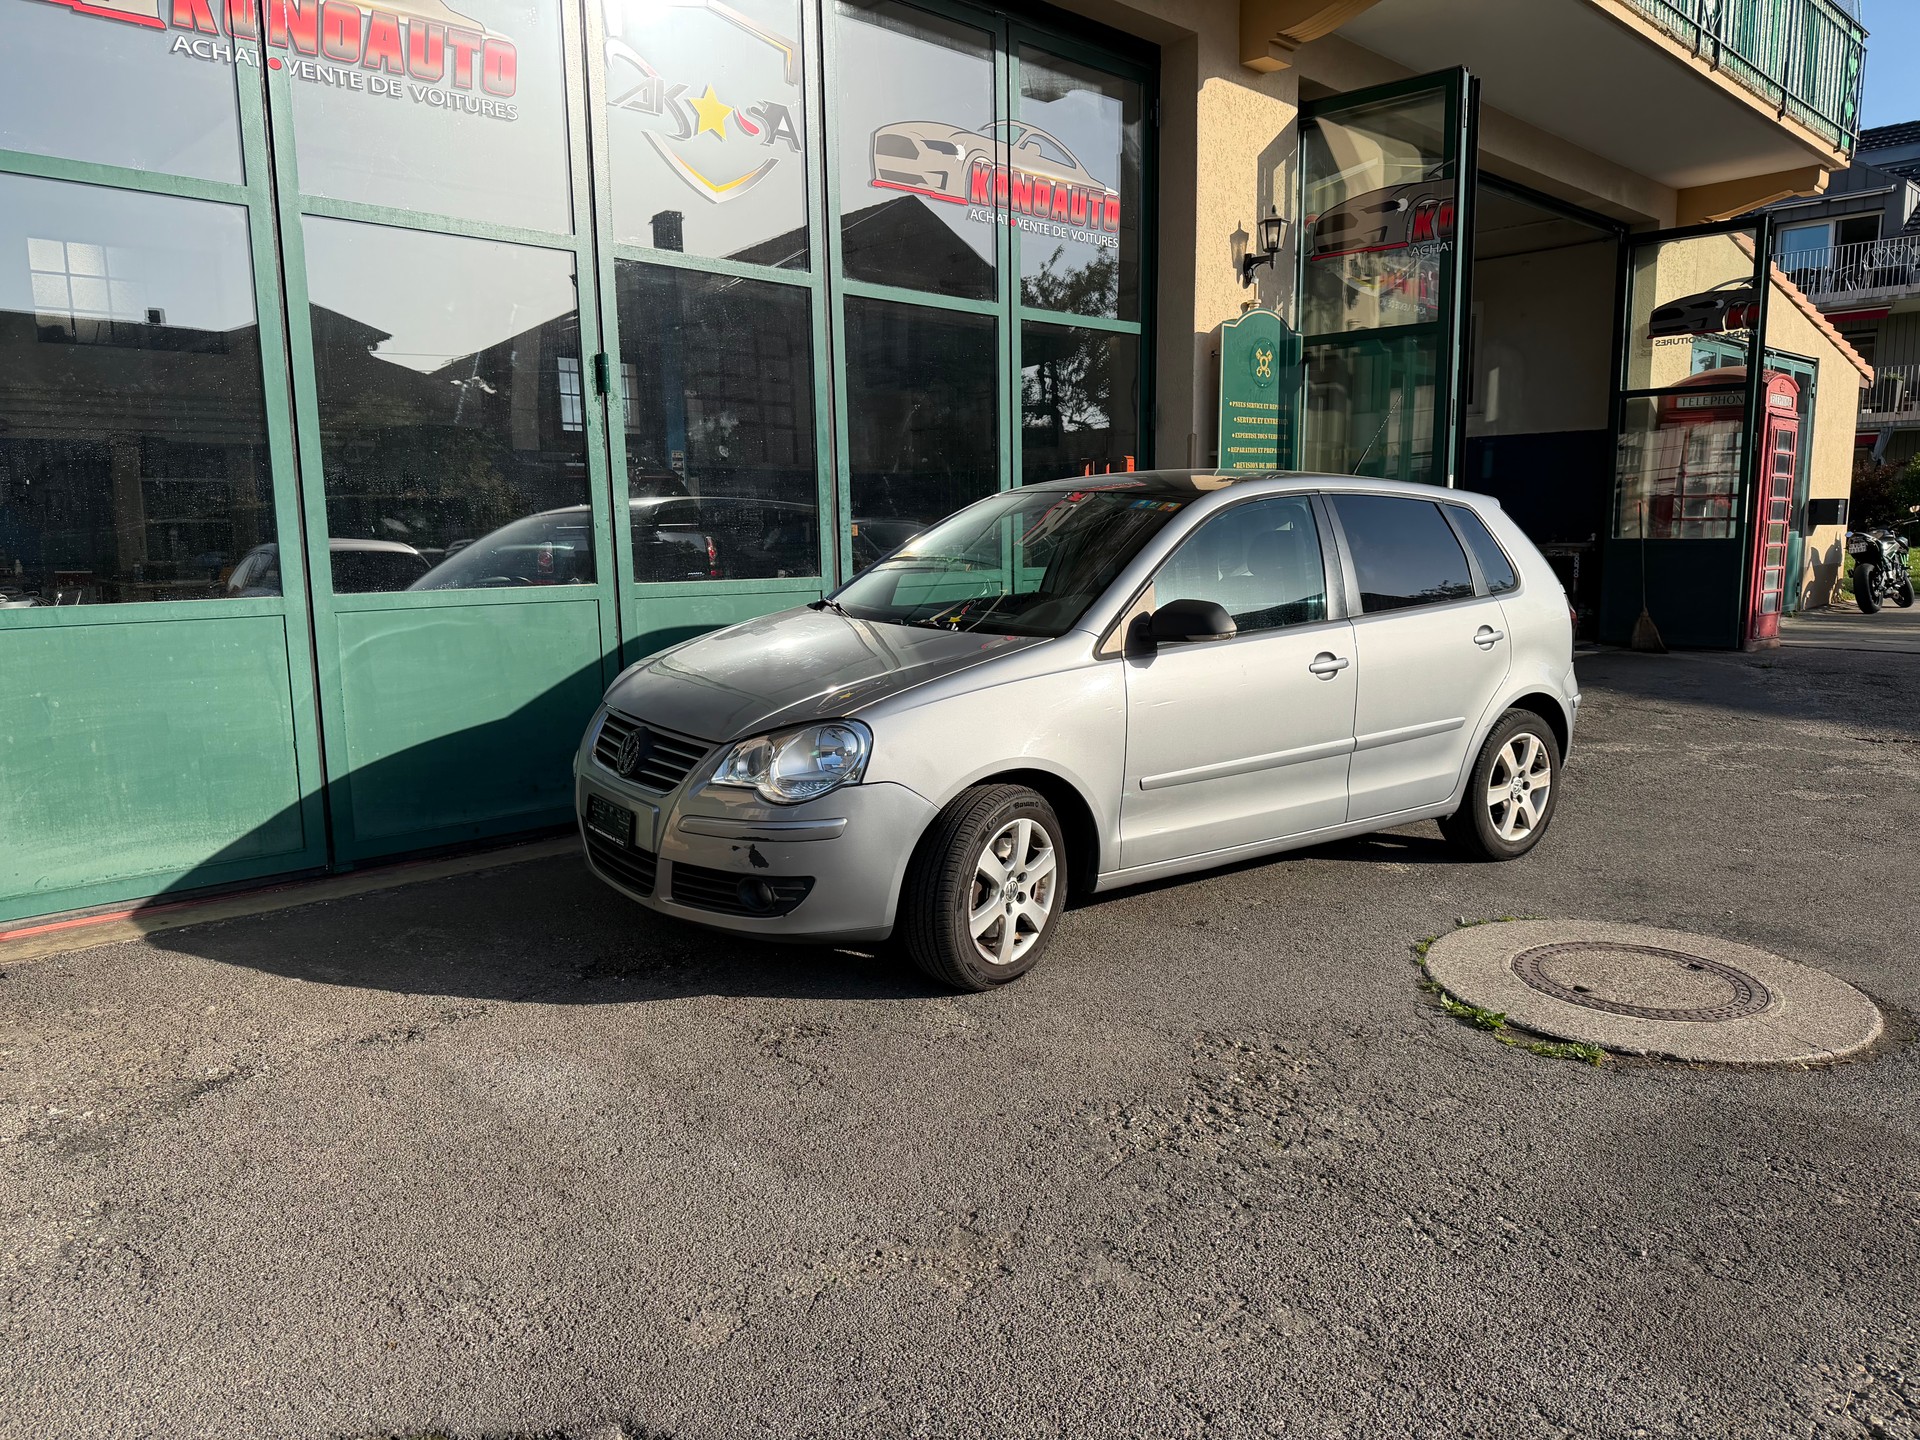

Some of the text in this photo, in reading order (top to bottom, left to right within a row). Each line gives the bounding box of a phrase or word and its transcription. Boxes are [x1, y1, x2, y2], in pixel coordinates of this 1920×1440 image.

[172, 35, 519, 121] ACHAT VENTE DE VOITURES
[970, 161, 1121, 233] KONOAUTO
[970, 208, 1119, 249] ACHAT VENTE DE VOITURES
[1236, 416, 1256, 424] SERVICE
[1681, 394, 1744, 407] TELEPHON
